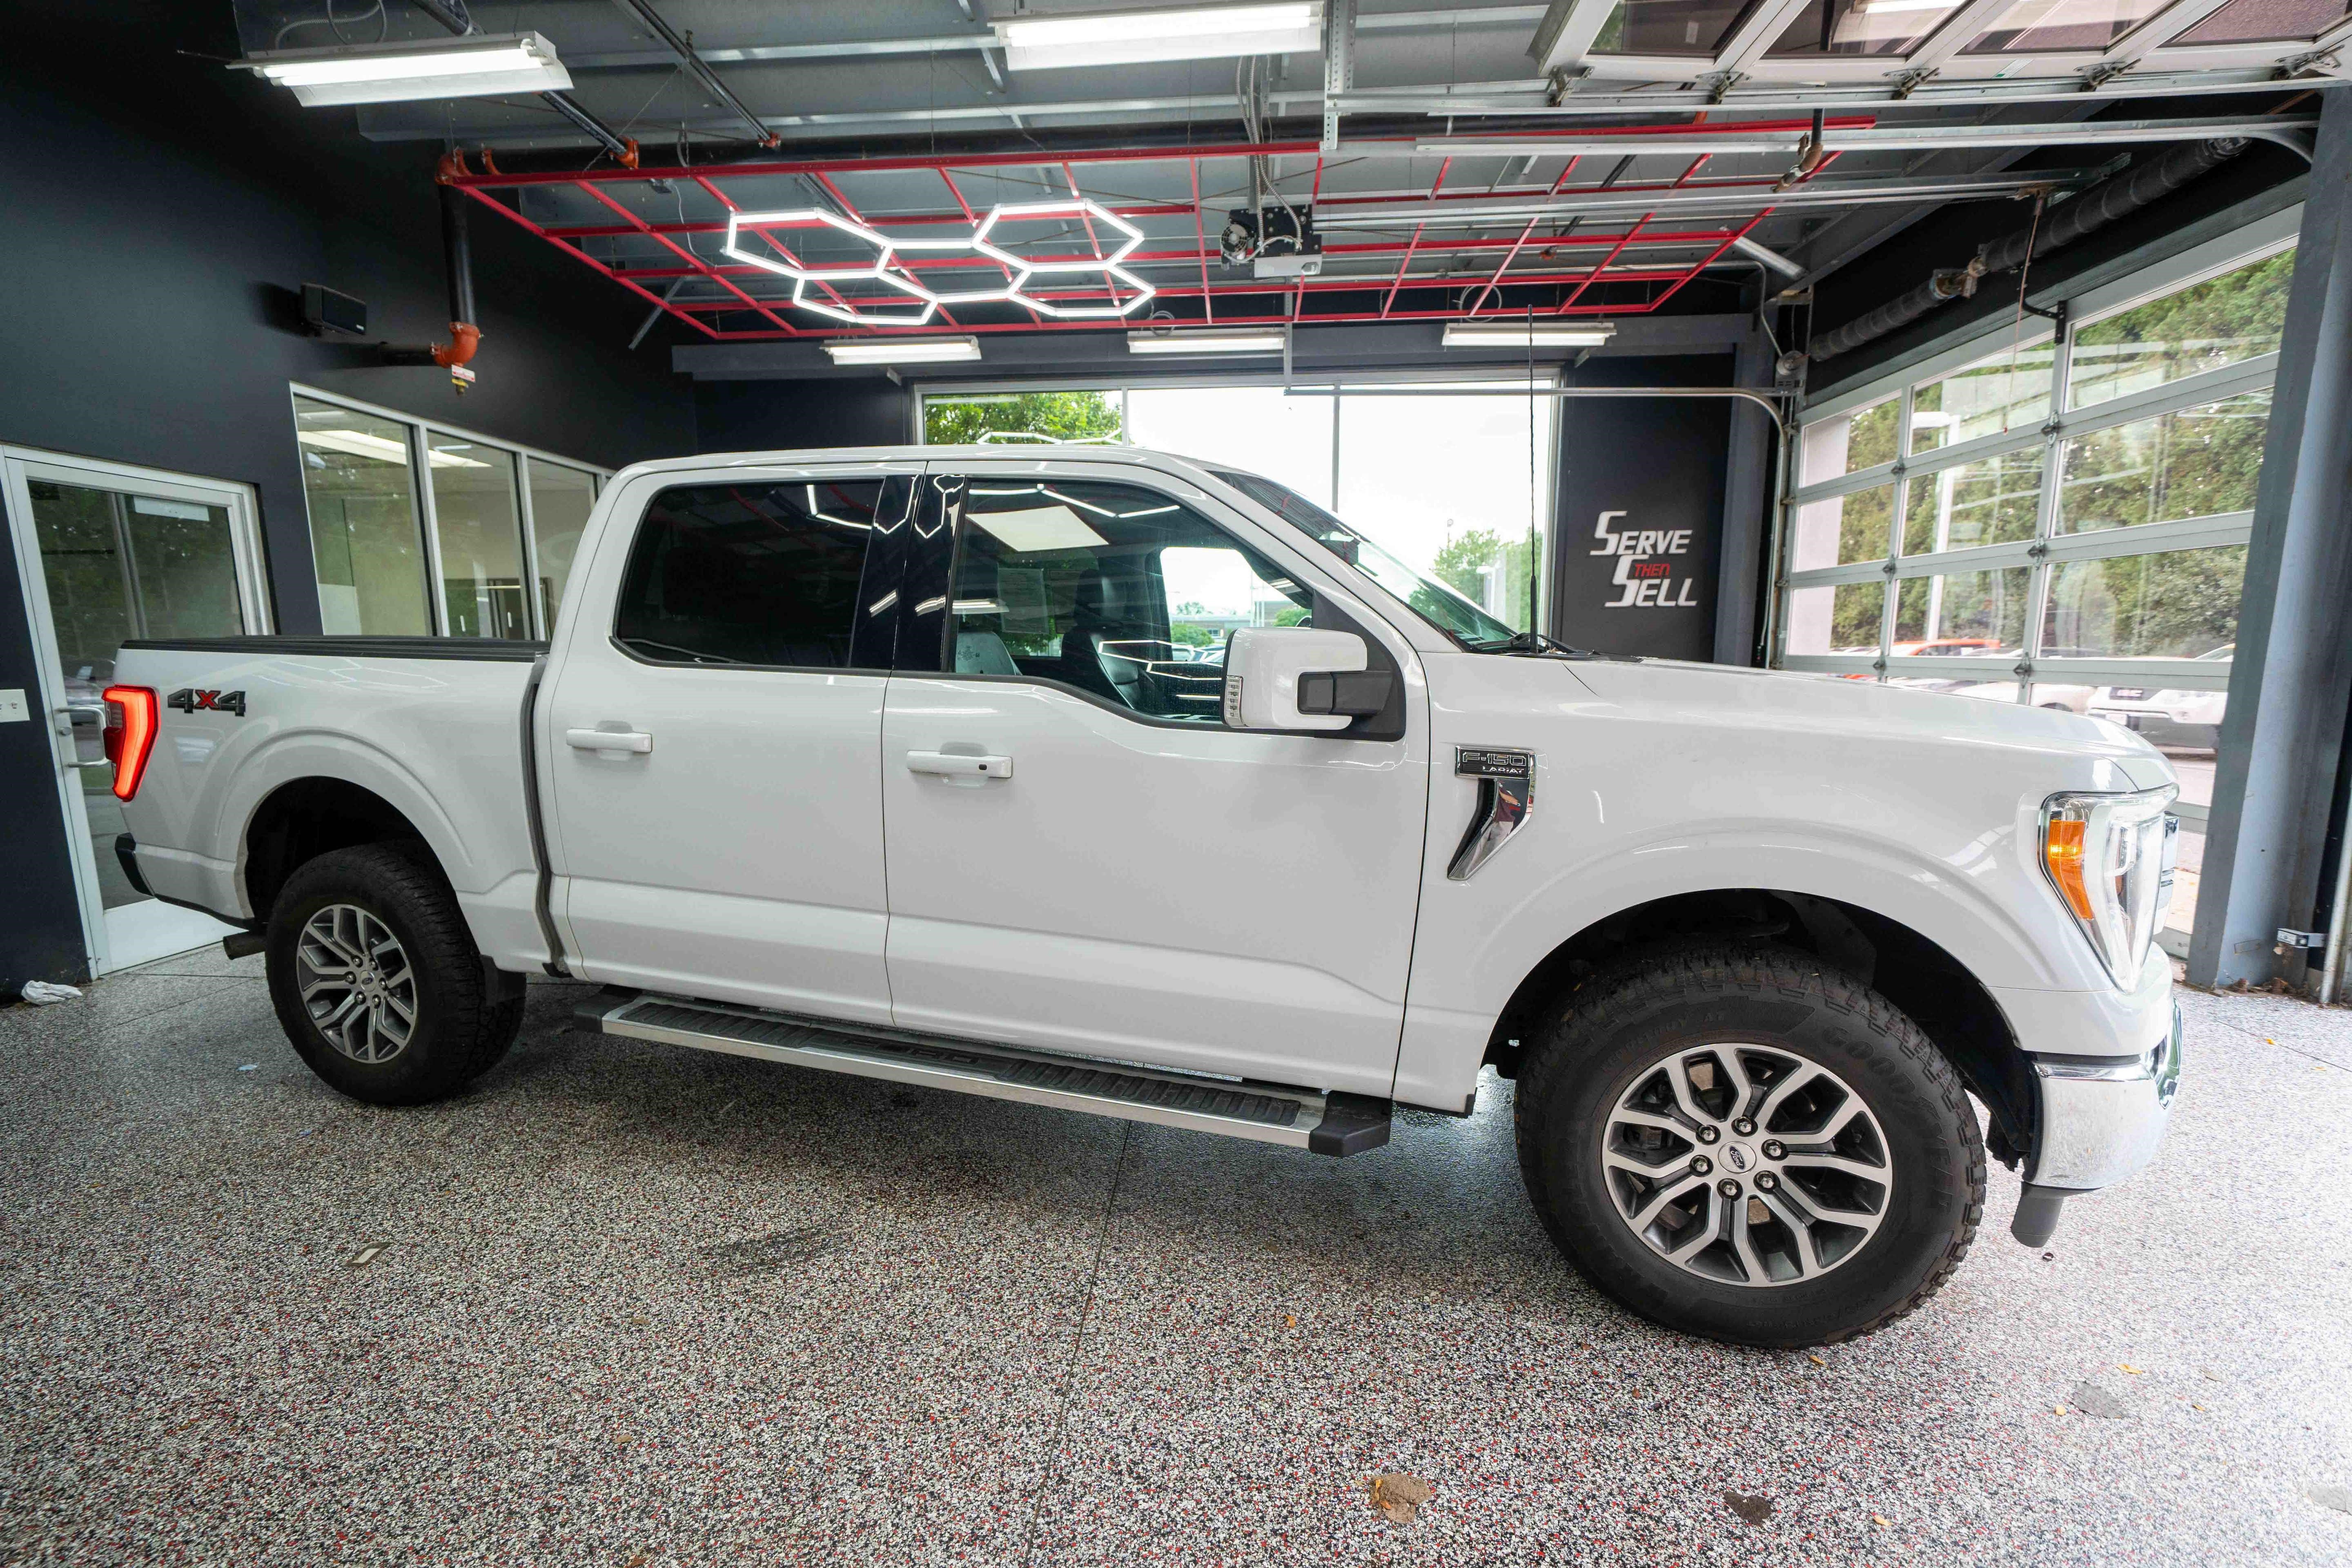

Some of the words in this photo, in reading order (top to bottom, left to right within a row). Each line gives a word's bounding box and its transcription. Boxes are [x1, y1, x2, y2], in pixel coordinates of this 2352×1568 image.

[1590, 510, 1693, 555] SERVE
[1604, 554, 1697, 607] SELL
[1463, 752, 1526, 766] F-150
[1482, 766, 1524, 774] LARIAT
[1730, 1149, 1744, 1169] Ford
